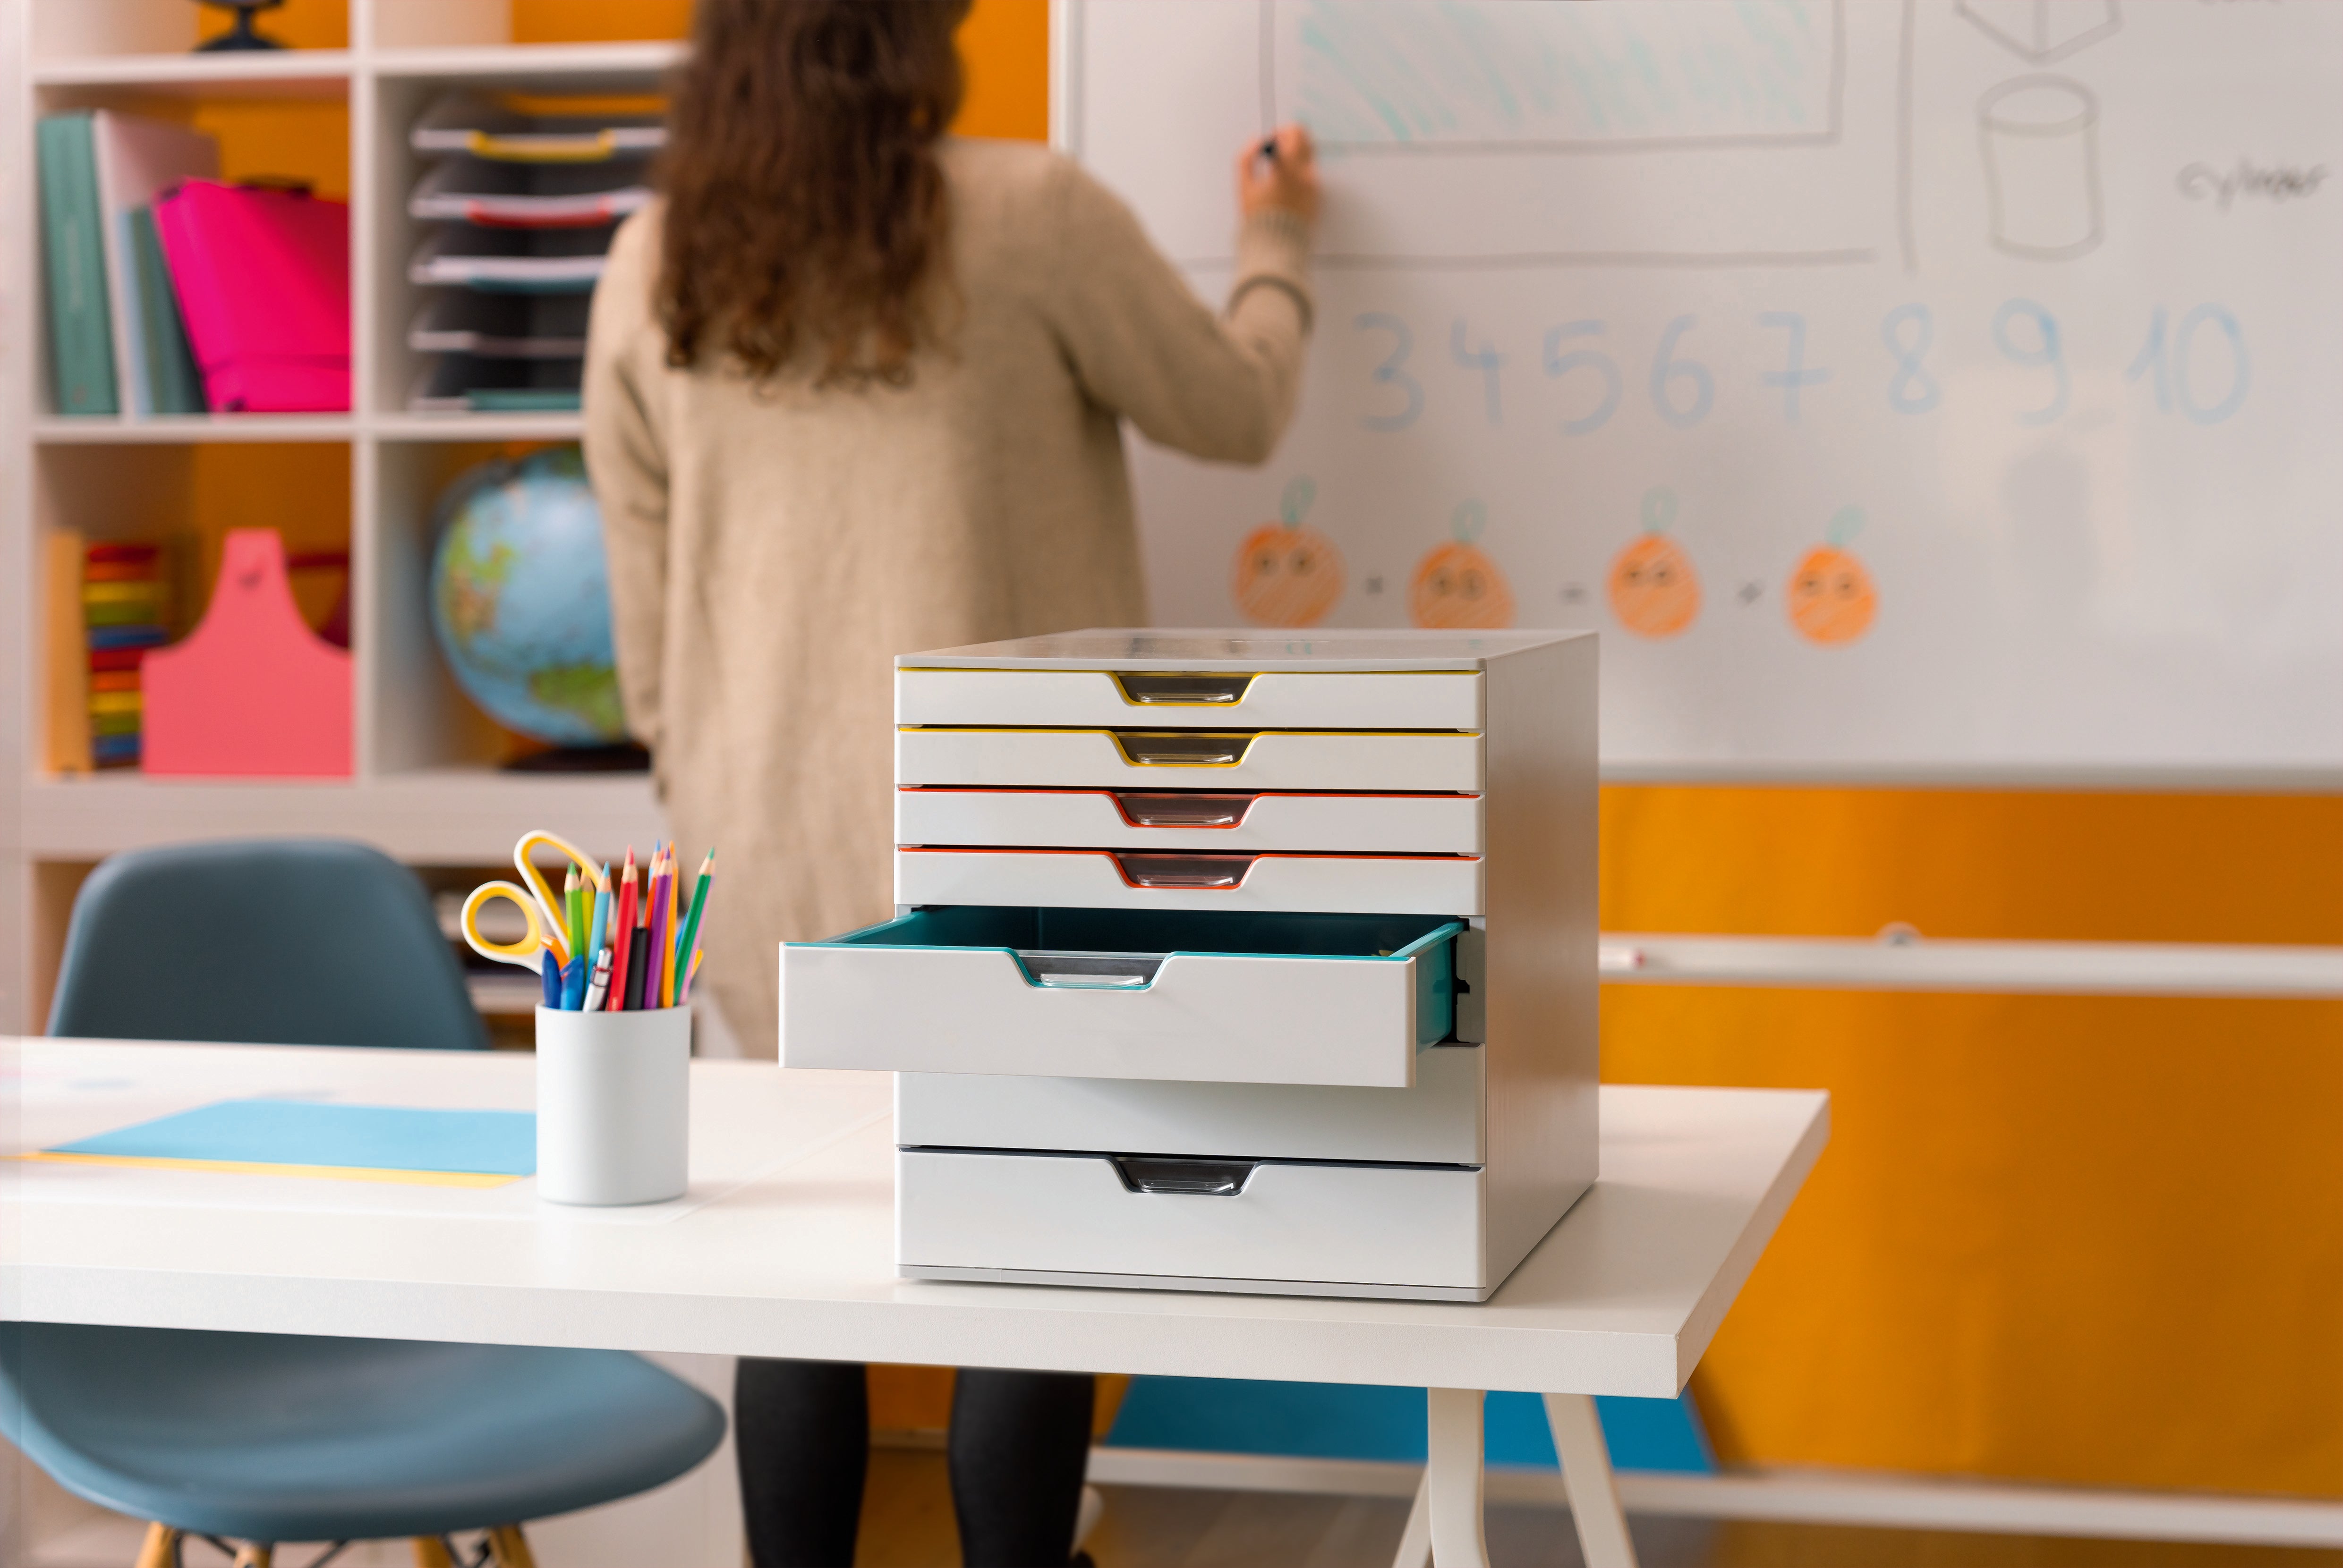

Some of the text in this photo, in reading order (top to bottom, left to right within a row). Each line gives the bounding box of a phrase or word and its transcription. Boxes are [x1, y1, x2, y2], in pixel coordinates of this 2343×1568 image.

[1352, 298, 2253, 436] 3 4 5 6 7 8 9 10
